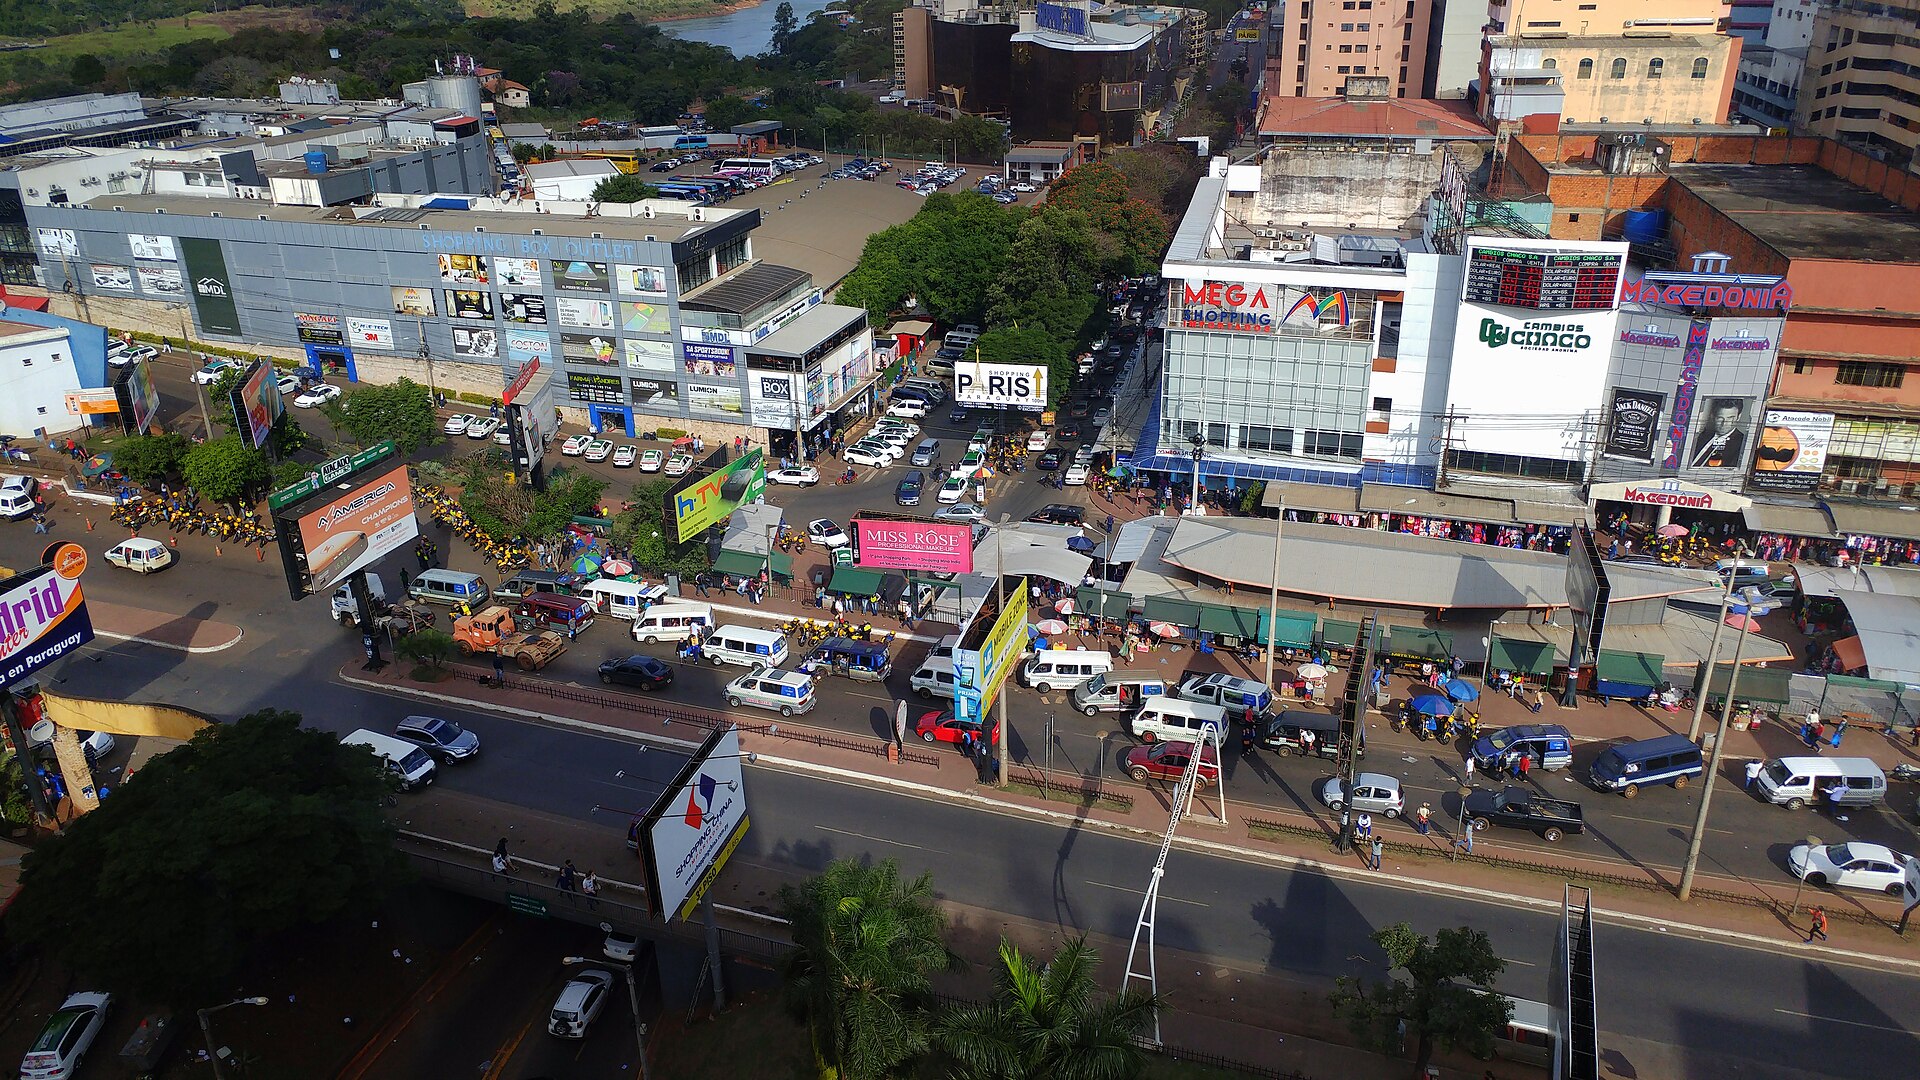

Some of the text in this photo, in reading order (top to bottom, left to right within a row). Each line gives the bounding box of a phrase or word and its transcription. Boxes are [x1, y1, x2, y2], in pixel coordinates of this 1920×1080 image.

[422, 234, 634, 259] SHOPPING BOX OUTLET
[1184, 282, 1269, 309] MEGA
[1620, 275, 1794, 310] MACEDONIA
[1183, 308, 1271, 325] SHOPPING
[1183, 320, 1271, 333] IMPORTADOS
[1523, 322, 1584, 332] CAMBIOS
[364, 333, 378, 342] 3M
[1620, 330, 1681, 348] MACEDONIA
[1711, 337, 1771, 351] MACEDONIA
[988, 370, 1030, 378] SHOPPING
[632, 380, 659, 390] LUMION
[689, 385, 718, 395] LUMION
[762, 381, 789, 395] BOX
[957, 394, 1030, 403] PARAGUAY
[1615, 401, 1633, 412] JACK
[322, 456, 350, 476] ATACADO
[1623, 486, 1713, 509] MACEDONIA
[361, 495, 409, 526] CHAMPIONS
[866, 529, 908, 543] MISS
[914, 529, 960, 547] RÔSE
[877, 541, 926, 551] PROFESSIONAL
[993, 612, 1013, 652] MOBILE
[8, 663, 25, 679] en
[25, 631, 82, 669] Paraguay
[957, 689, 978, 697] PRIME
[675, 797, 733, 879] SHOPPING CHINA
[702, 867, 718, 893] PISO
